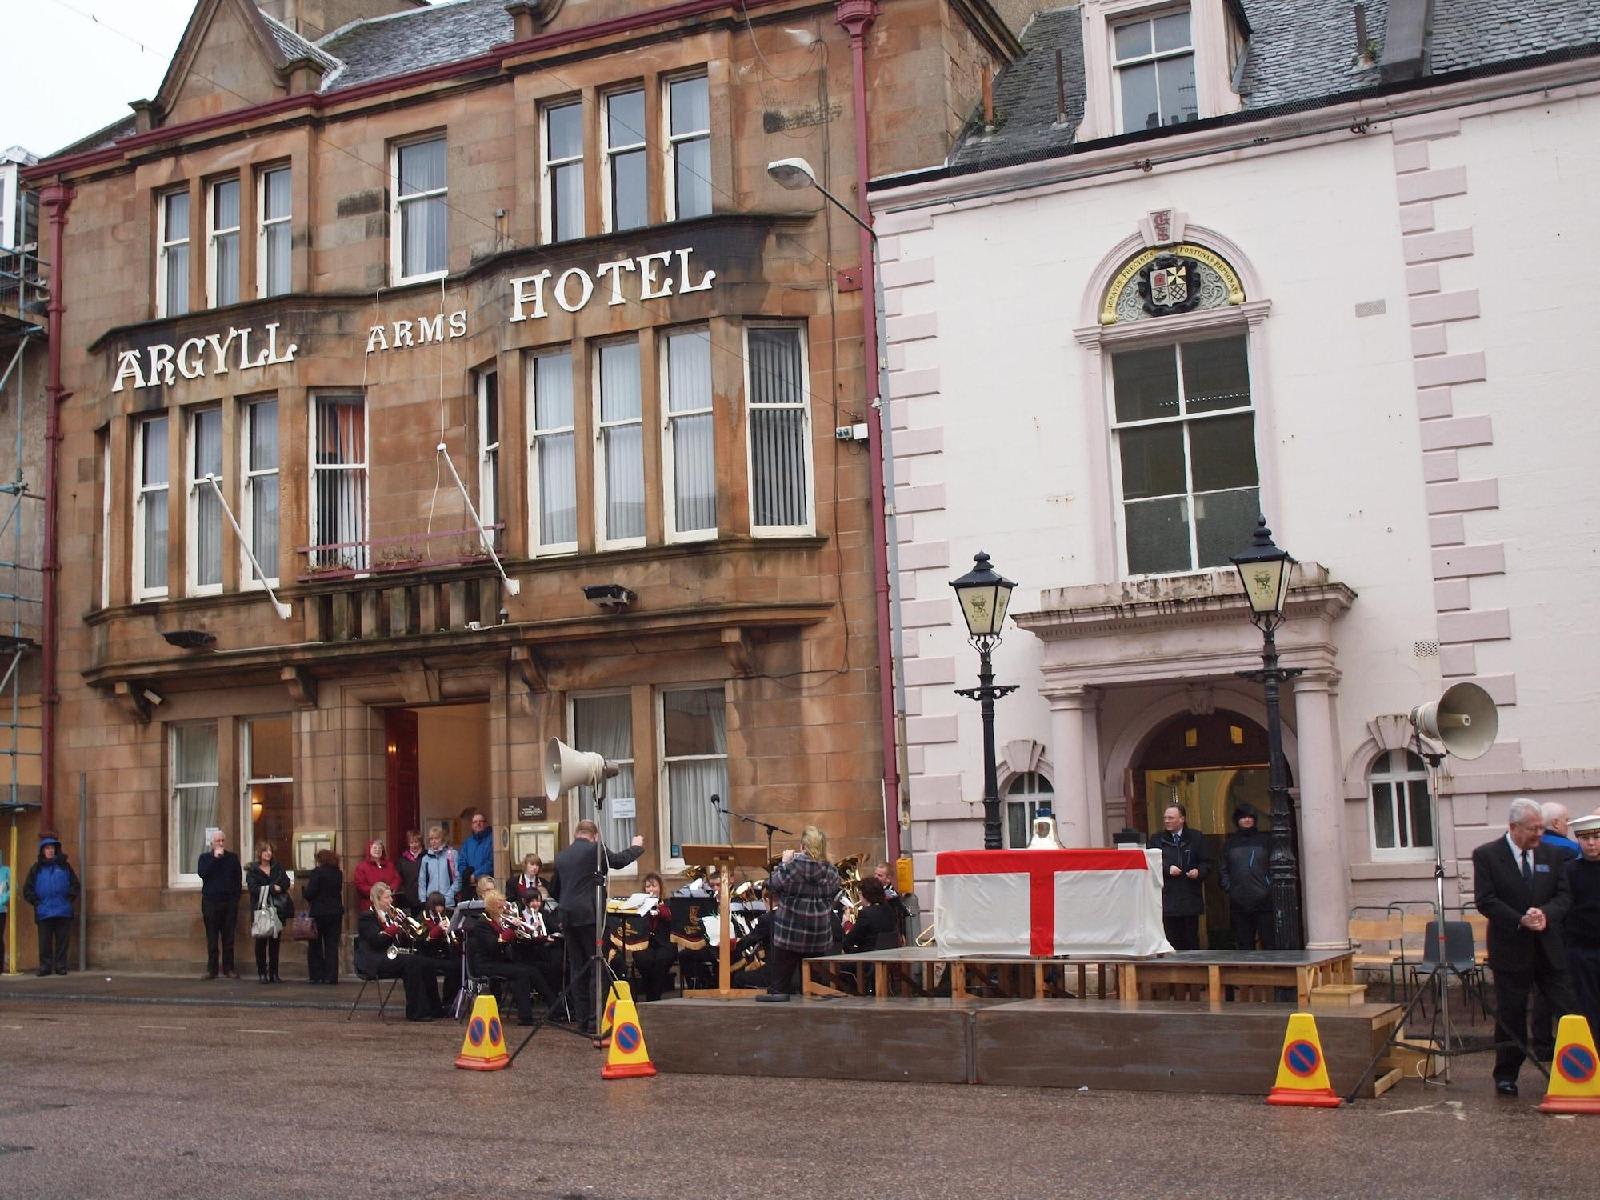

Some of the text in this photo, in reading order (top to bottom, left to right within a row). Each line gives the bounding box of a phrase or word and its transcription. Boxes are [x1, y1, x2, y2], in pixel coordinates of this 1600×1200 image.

[112, 247, 717, 392] ARGYLL ARMS HOTEL
